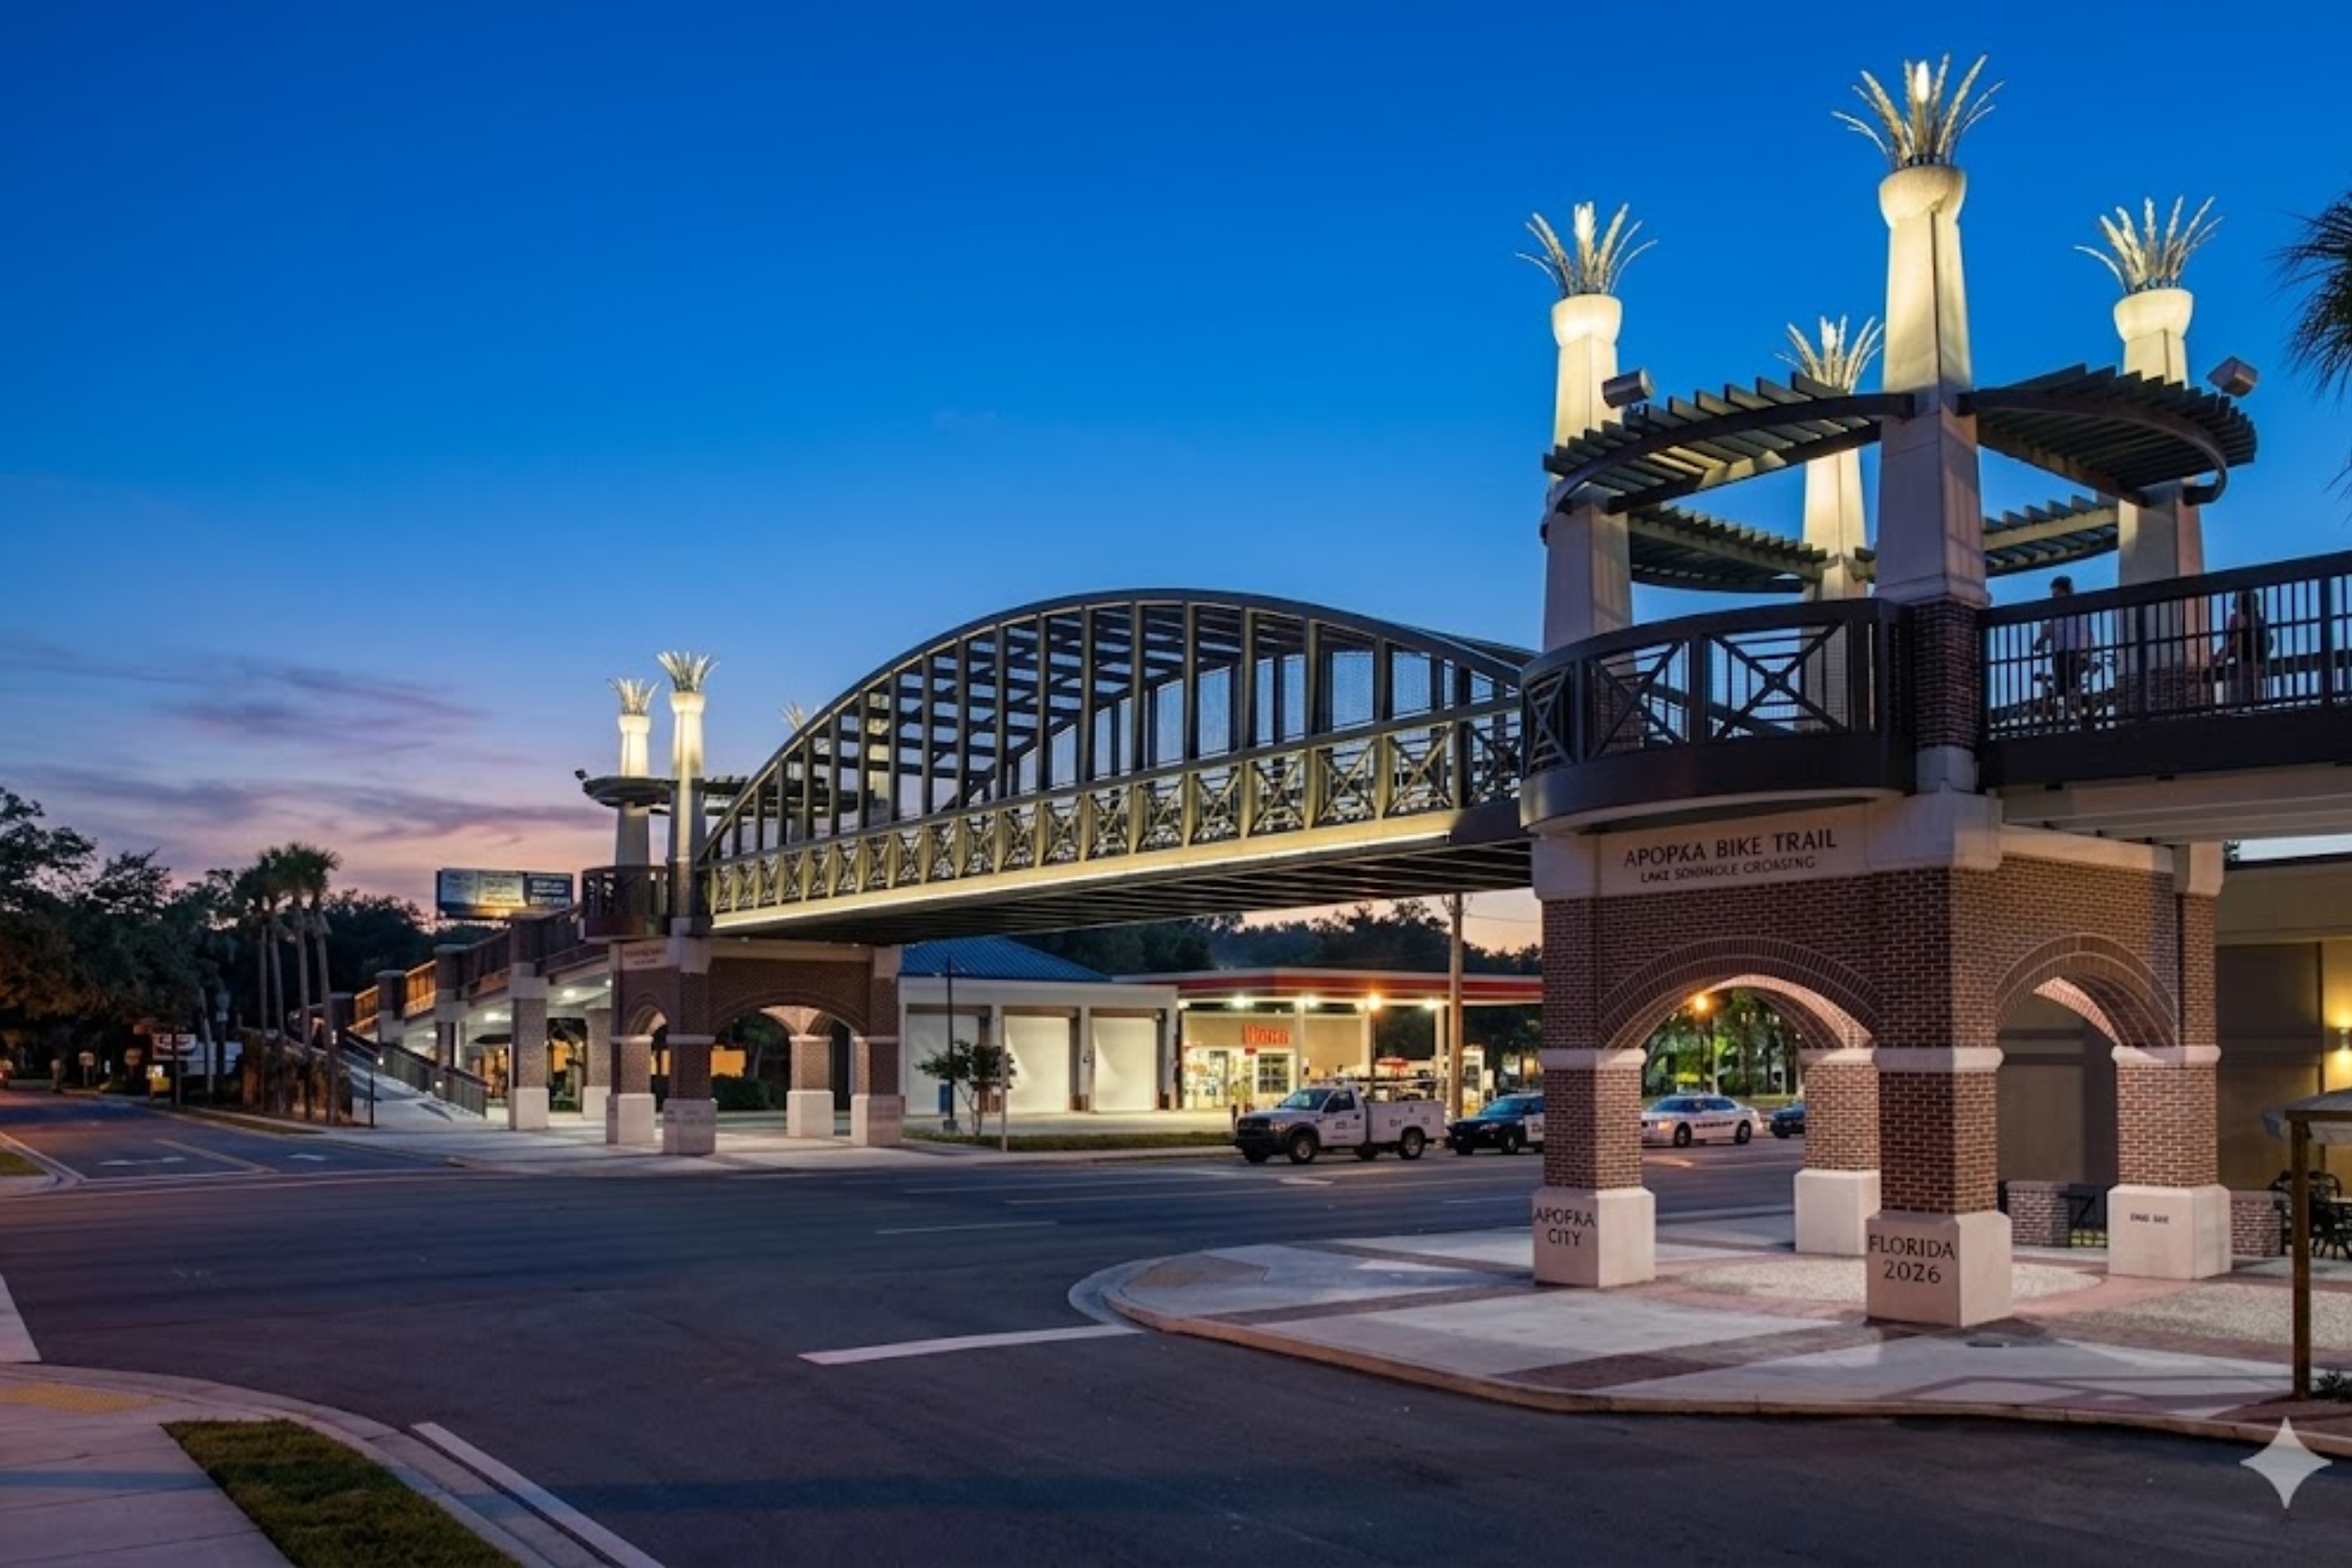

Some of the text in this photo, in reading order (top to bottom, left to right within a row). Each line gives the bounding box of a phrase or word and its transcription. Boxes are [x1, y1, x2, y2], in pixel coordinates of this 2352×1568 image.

[1625, 829, 1837, 867] APOPKA BIKE TRAIL
[1547, 1228, 1582, 1246] CITY
[1868, 1234, 1956, 1260] FLORIDA
[1883, 1259, 1942, 1285] 2026
